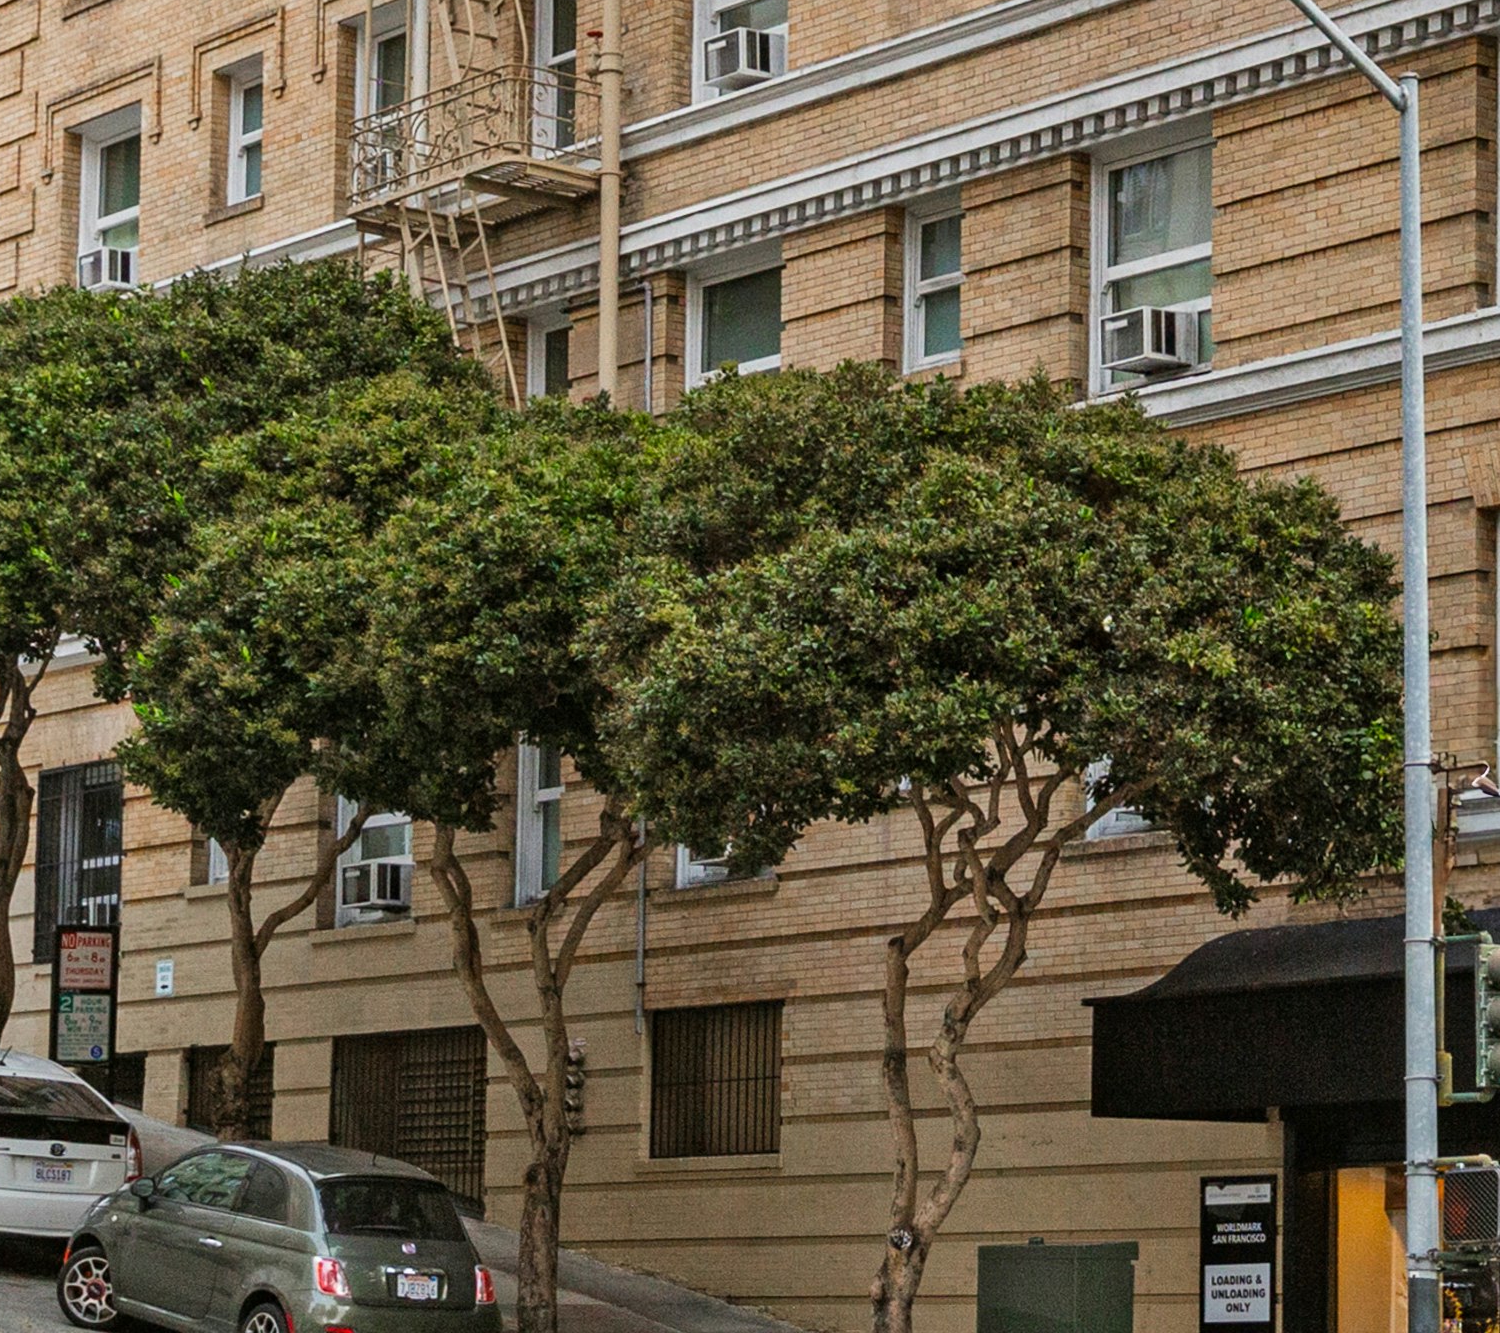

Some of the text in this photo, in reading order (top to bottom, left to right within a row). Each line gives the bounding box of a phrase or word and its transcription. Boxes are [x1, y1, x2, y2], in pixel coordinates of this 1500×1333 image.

[62, 933, 110, 948] NO PARKING
[60, 996, 71, 1011] 2
[1216, 1222, 1262, 1232] WORLDMARK
[1212, 1233, 1266, 1244] SAN FRANCISCO
[1211, 1274, 1262, 1285] LOADING &
[1211, 1288, 1266, 1299] UNLOADING
[1226, 1303, 1251, 1313] ONLY
